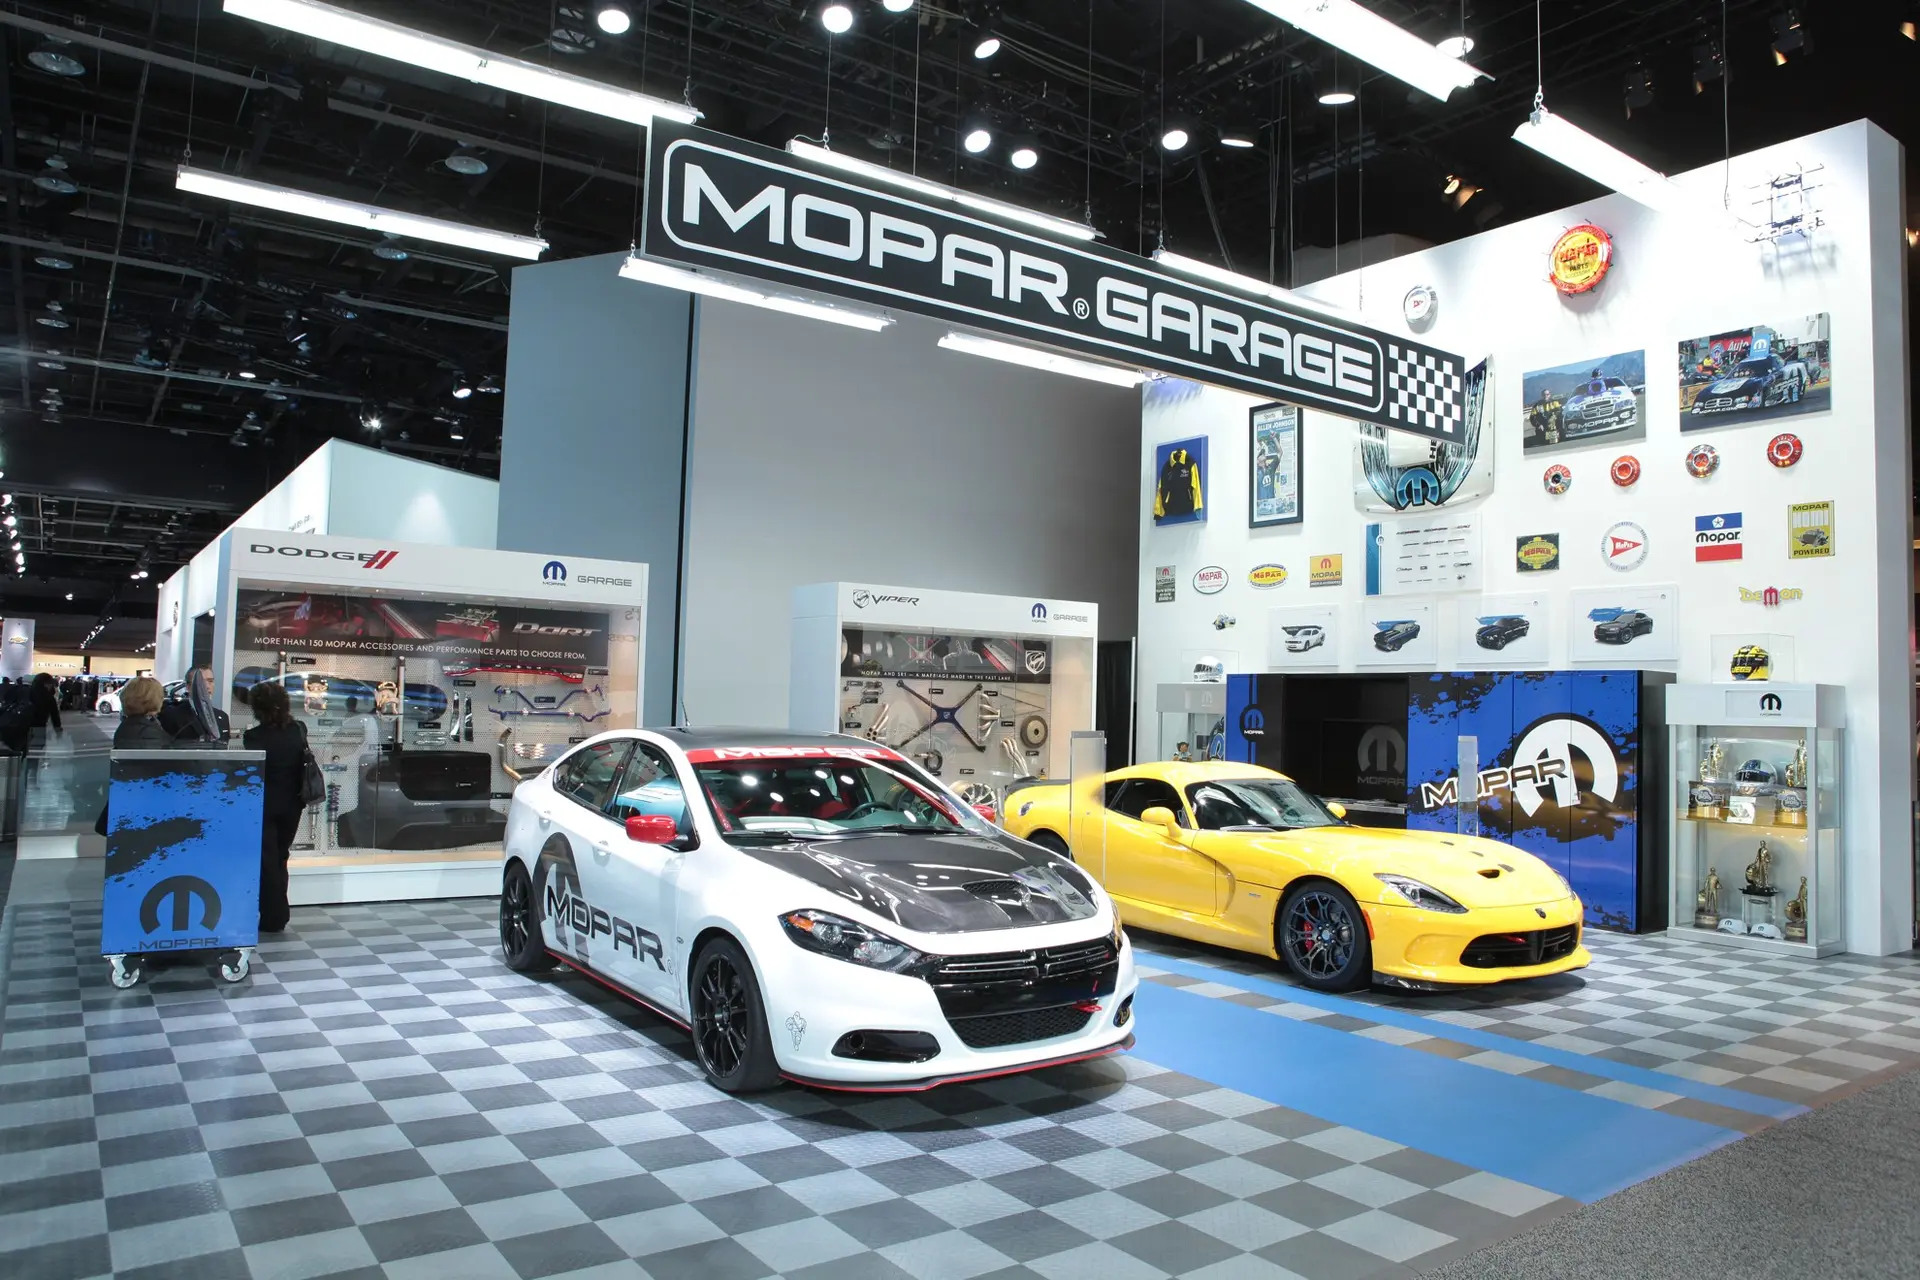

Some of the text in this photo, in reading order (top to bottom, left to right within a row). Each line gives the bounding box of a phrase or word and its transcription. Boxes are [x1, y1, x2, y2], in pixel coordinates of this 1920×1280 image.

[1096, 276, 1373, 397] GARAGE
[1578, 416, 1620, 431] MOPAR
[1792, 503, 1830, 512] MOPAR
[250, 544, 379, 563] DODGE
[1793, 548, 1830, 556] POWERED
[577, 575, 633, 587] GARAGE
[1311, 571, 1341, 579] MOPAR
[871, 594, 920, 607] VIPER
[1053, 613, 1088, 623] GARAGE
[254, 636, 281, 645] MORE
[283, 637, 307, 646] THAN
[309, 639, 324, 647] 150
[325, 640, 357, 649] MOPAR
[359, 641, 414, 651] ACCESSORIES
[416, 644, 435, 652] AND
[436, 645, 494, 656] PERFORMANCE
[495, 649, 518, 657] PARTS
[519, 650, 530, 658] TO
[531, 650, 563, 659] CHOOSE
[713, 747, 888, 760] MOPAR
[1357, 775, 1406, 787] MOPAR
[1421, 757, 1568, 809] MPAR
[547, 884, 667, 973] MOPAR
[139, 937, 220, 951] MOPAR
